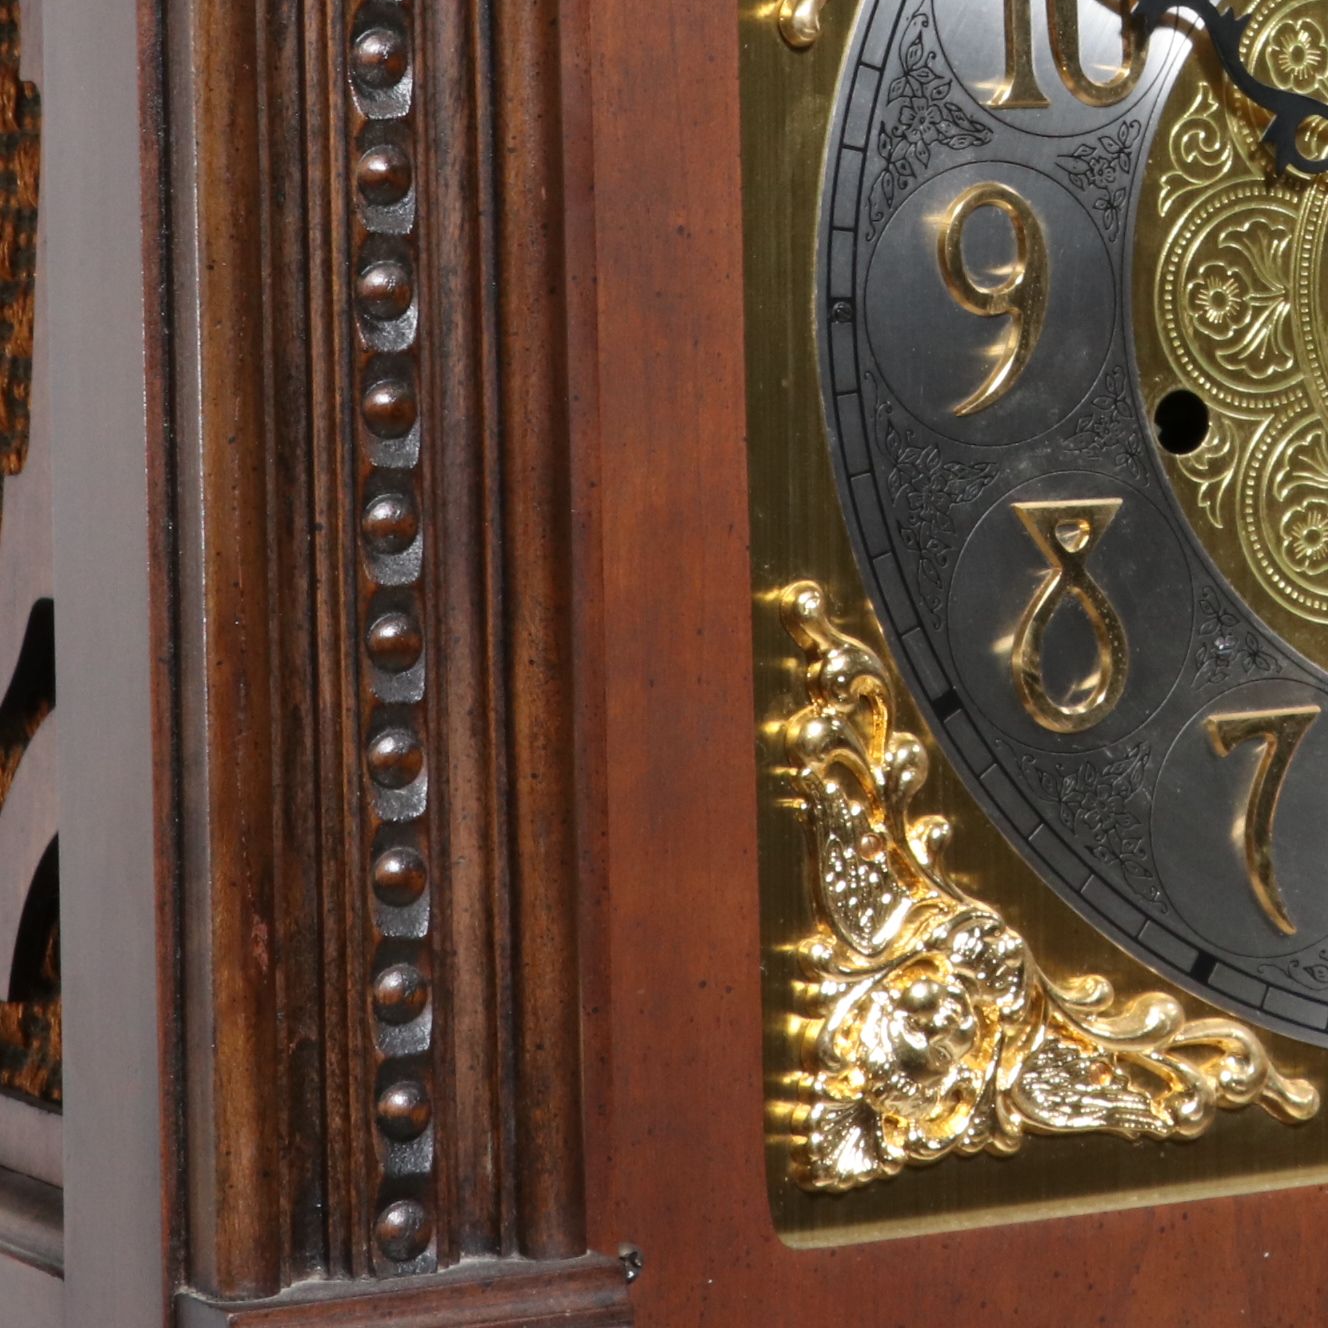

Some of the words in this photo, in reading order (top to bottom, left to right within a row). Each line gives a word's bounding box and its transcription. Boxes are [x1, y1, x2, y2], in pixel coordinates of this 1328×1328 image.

[937, 182, 1048, 417] 9
[1010, 498, 1130, 734] 8
[1204, 705, 1322, 935] 7
